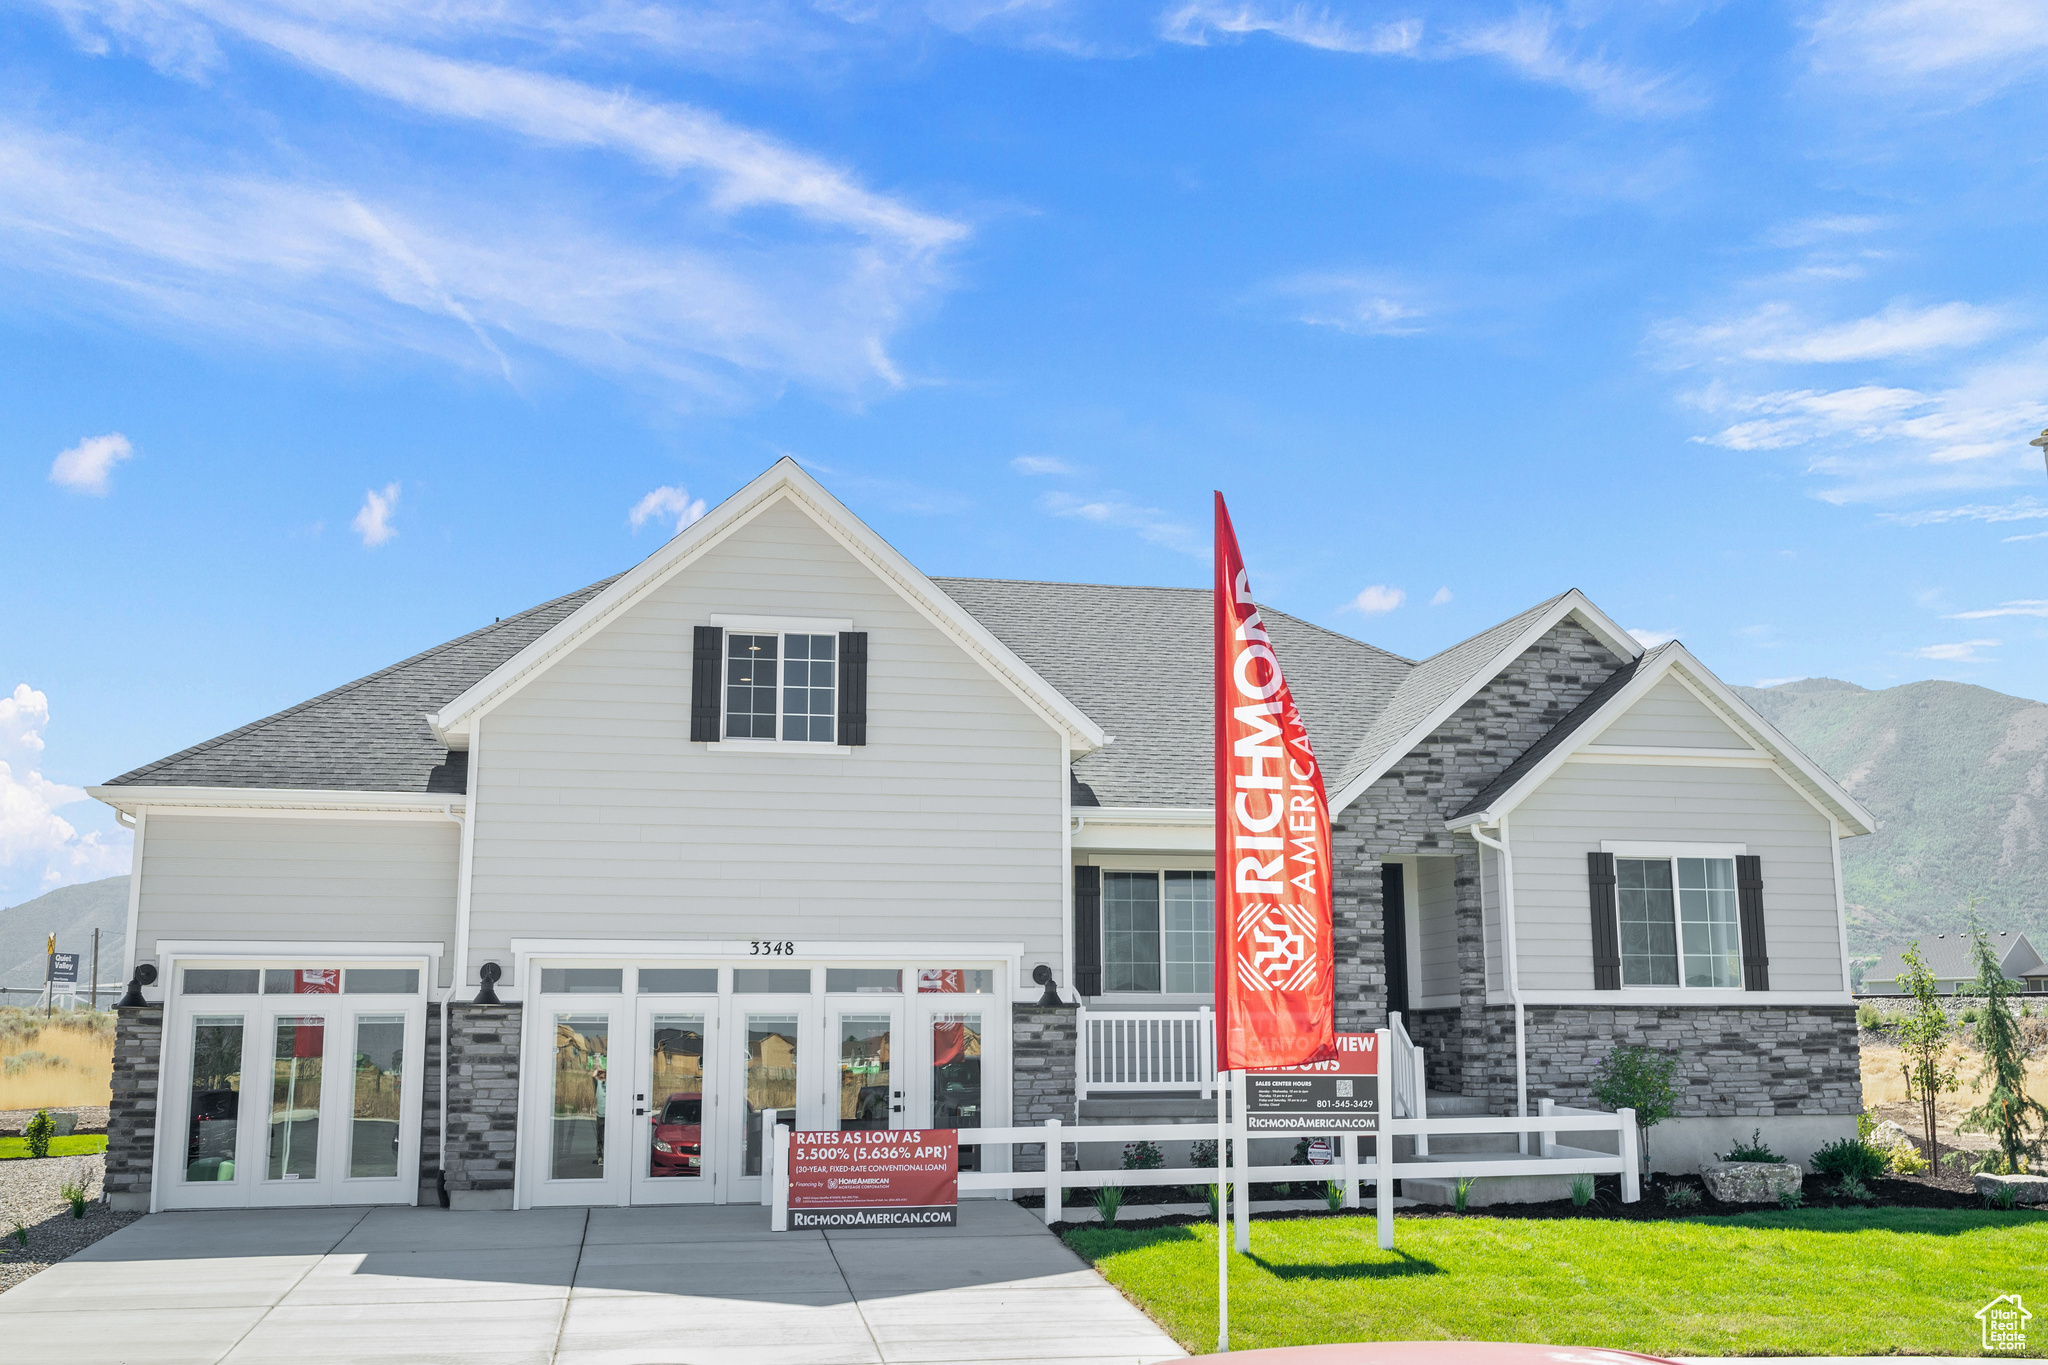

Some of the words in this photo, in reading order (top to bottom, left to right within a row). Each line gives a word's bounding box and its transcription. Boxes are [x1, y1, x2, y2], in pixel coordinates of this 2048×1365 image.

[750, 942, 794, 956] 3348
[55, 954, 72, 962] Quiet
[54, 962, 74, 970] Valley
[1316, 1100, 1373, 1108] 801-545-3429
[796, 1132, 839, 1144] RATES
[843, 1132, 861, 1144] AS
[865, 1132, 899, 1144] LOW
[902, 1131, 921, 1143] AS
[796, 1148, 850, 1160] 5.500%
[854, 1146, 911, 1162] (5.636%
[796, 1165, 828, 1173] (30-YEAR,
[868, 1164, 924, 1172] CONVENTIONAL
[924, 1163, 947, 1172] LOAN)
[795, 1181, 817, 1189] Financing
